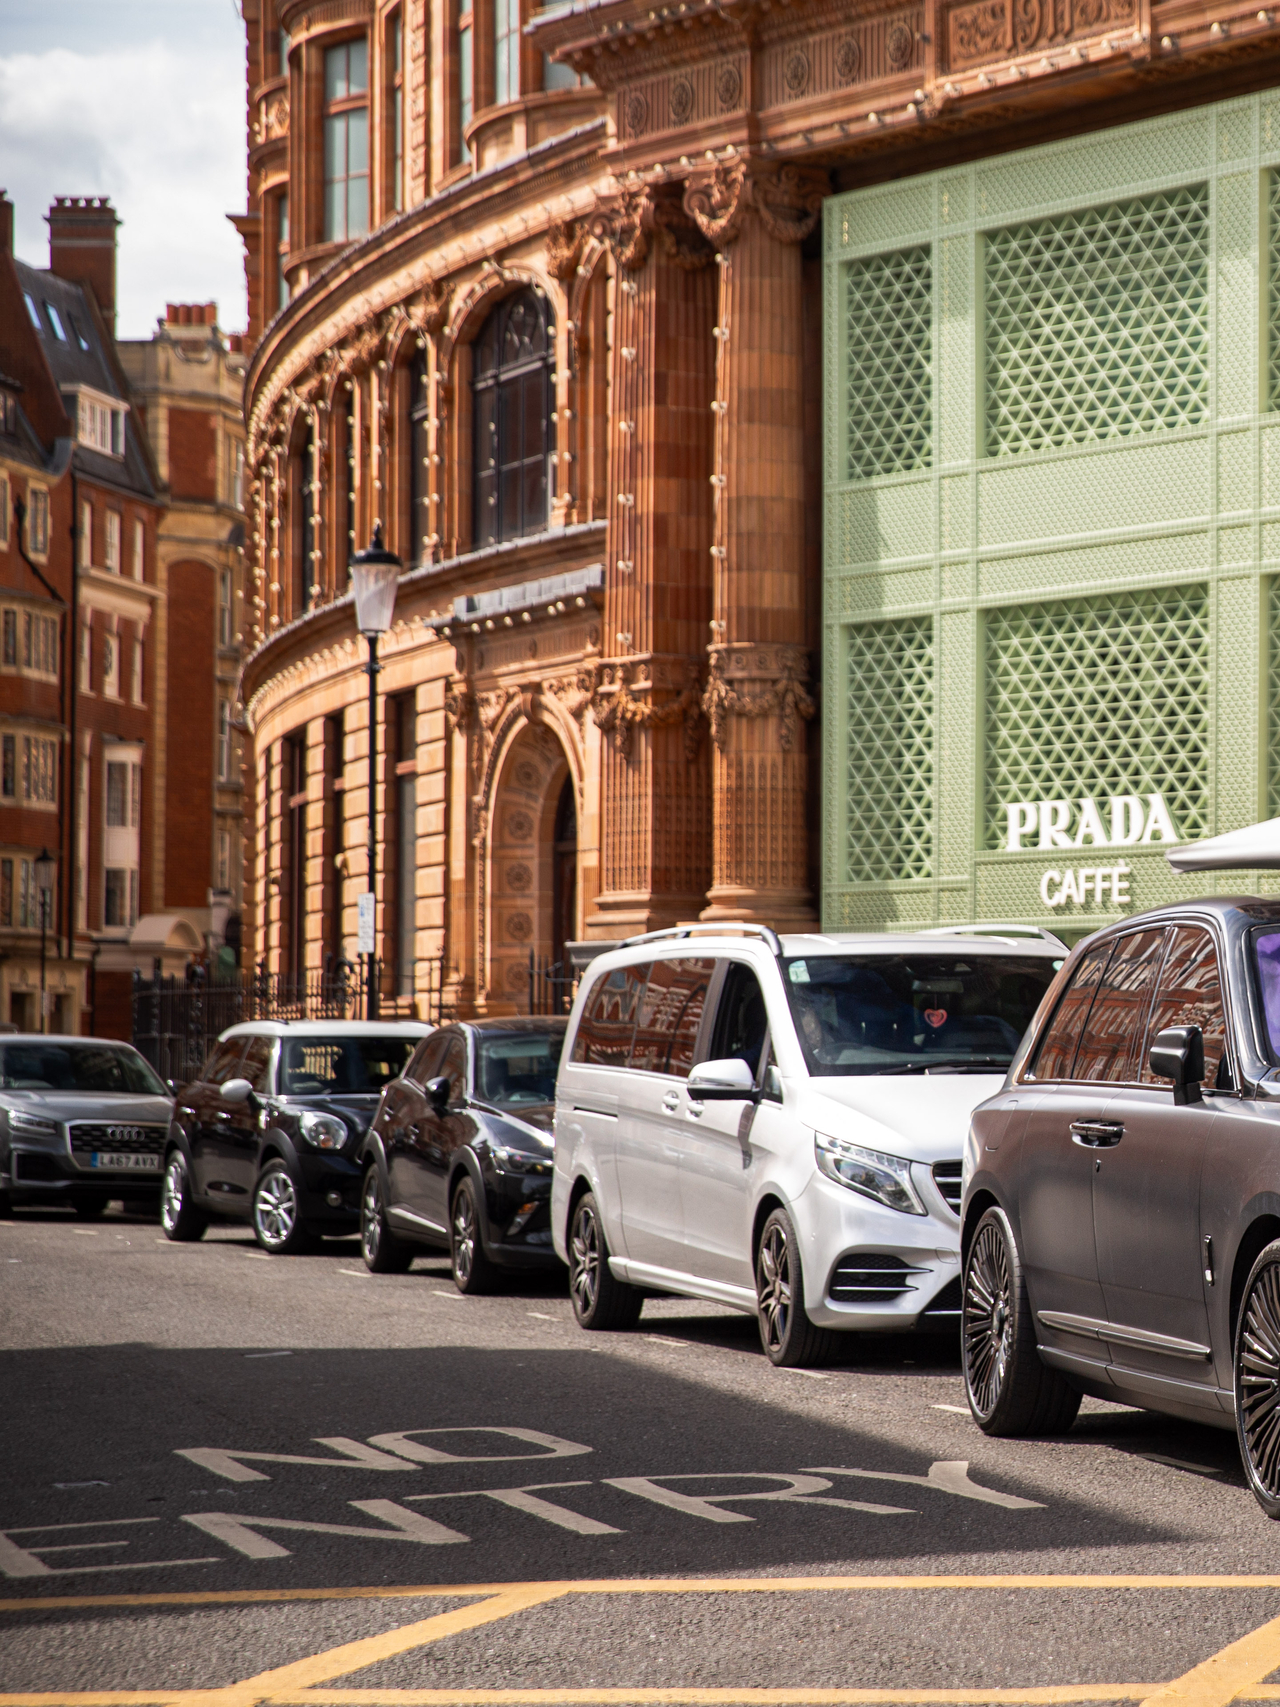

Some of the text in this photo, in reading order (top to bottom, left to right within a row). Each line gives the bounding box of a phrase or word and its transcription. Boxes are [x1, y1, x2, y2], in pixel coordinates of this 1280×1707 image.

[1007, 793, 1179, 850] PRADA
[173, 1427, 594, 1482] NO
[0, 1460, 1048, 1578] ENTRY
